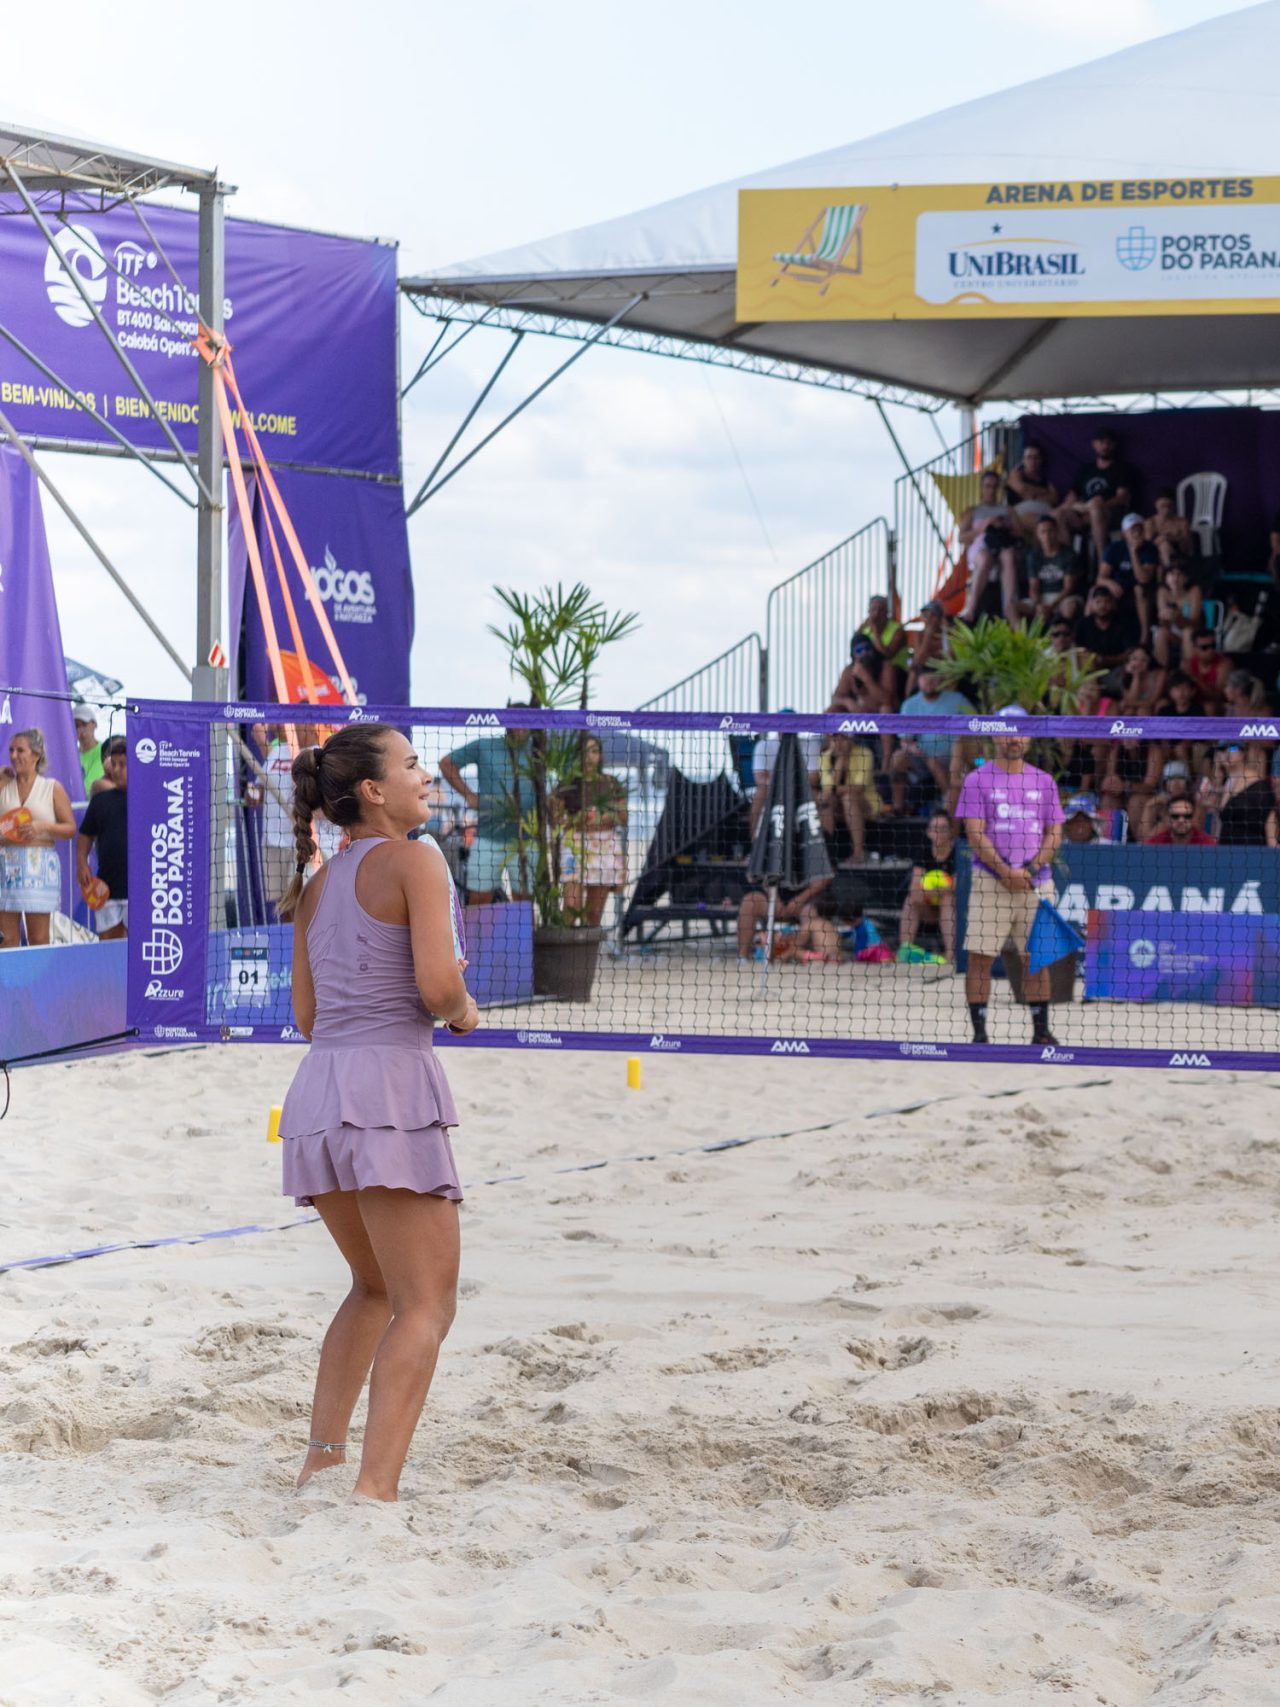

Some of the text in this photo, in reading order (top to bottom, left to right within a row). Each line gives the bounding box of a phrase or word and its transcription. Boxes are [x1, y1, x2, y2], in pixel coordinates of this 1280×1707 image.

[986, 178, 1254, 204] ARENA DE ESPORTES
[1162, 234, 1251, 252] PORTOS
[117, 251, 145, 277] ITF
[1162, 253, 1193, 270] DO
[117, 309, 152, 330] BT400
[229, 407, 297, 437] WLCOME
[163, 776, 184, 882] PARANÁ
[151, 823, 168, 925] PORTOS
[168, 887, 184, 925] DO
[238, 970, 259, 985] 01
